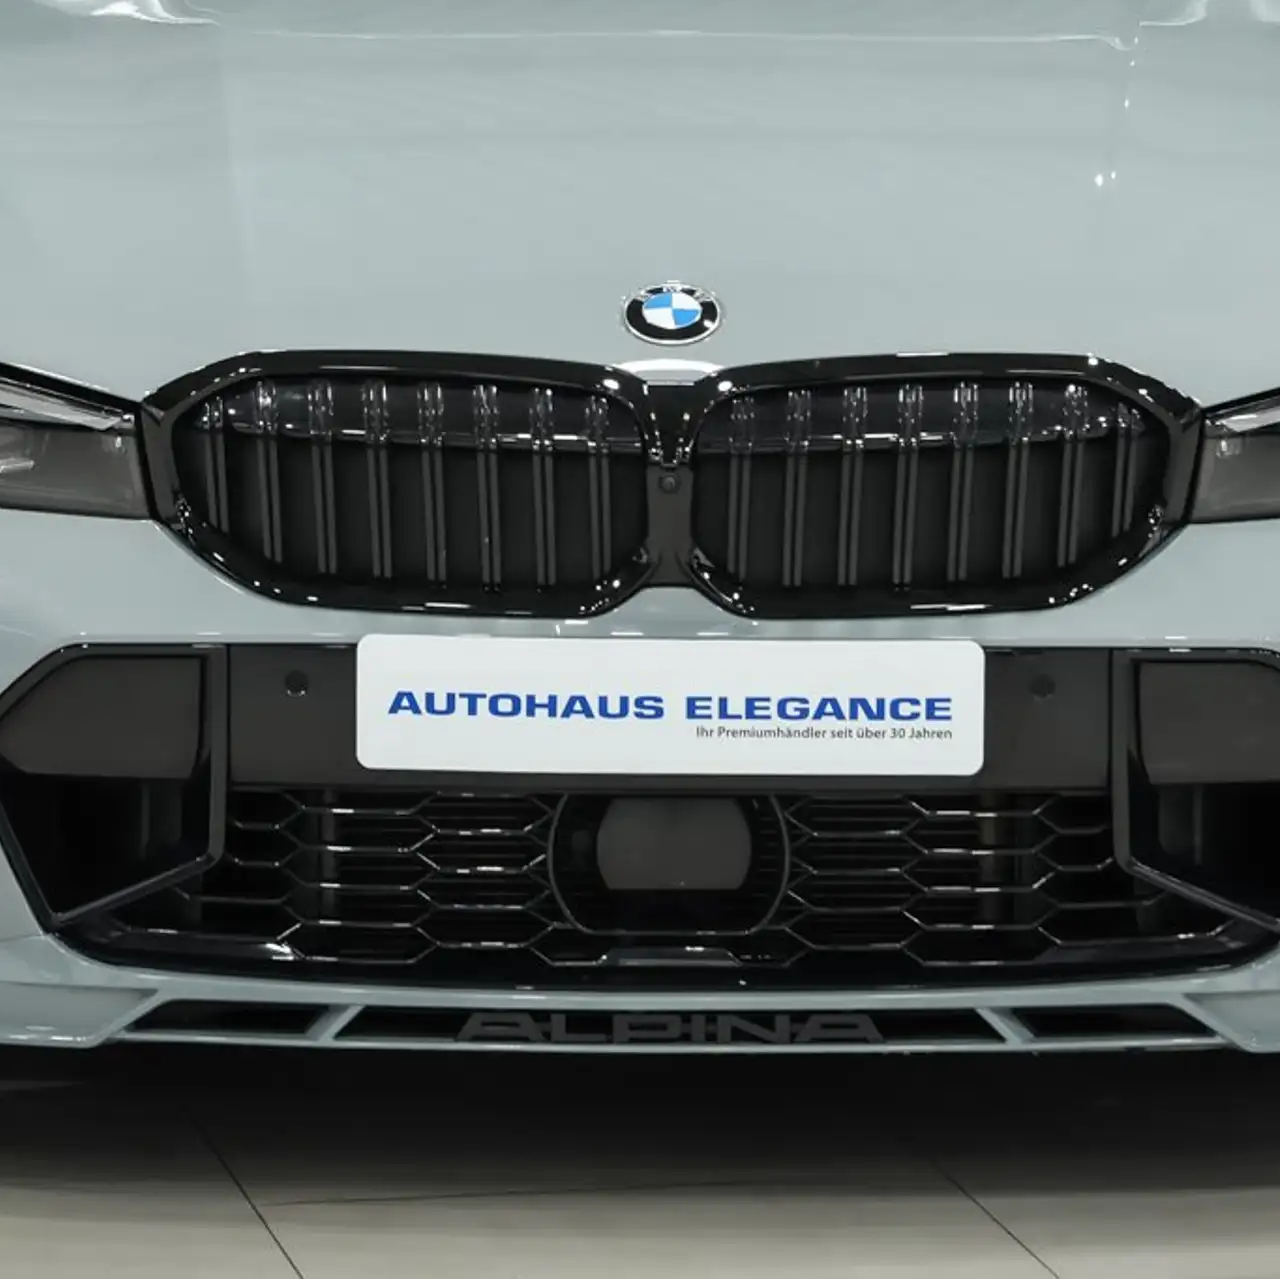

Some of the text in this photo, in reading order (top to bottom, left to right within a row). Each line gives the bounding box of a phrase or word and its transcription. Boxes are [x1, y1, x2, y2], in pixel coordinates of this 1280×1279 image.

[387, 690, 953, 721] AUTOHAUS ELEGANCE
[696, 726, 953, 739] Ihr Premiumhändler seit über 30 Jahren
[456, 1012, 887, 1043] ALPINA
